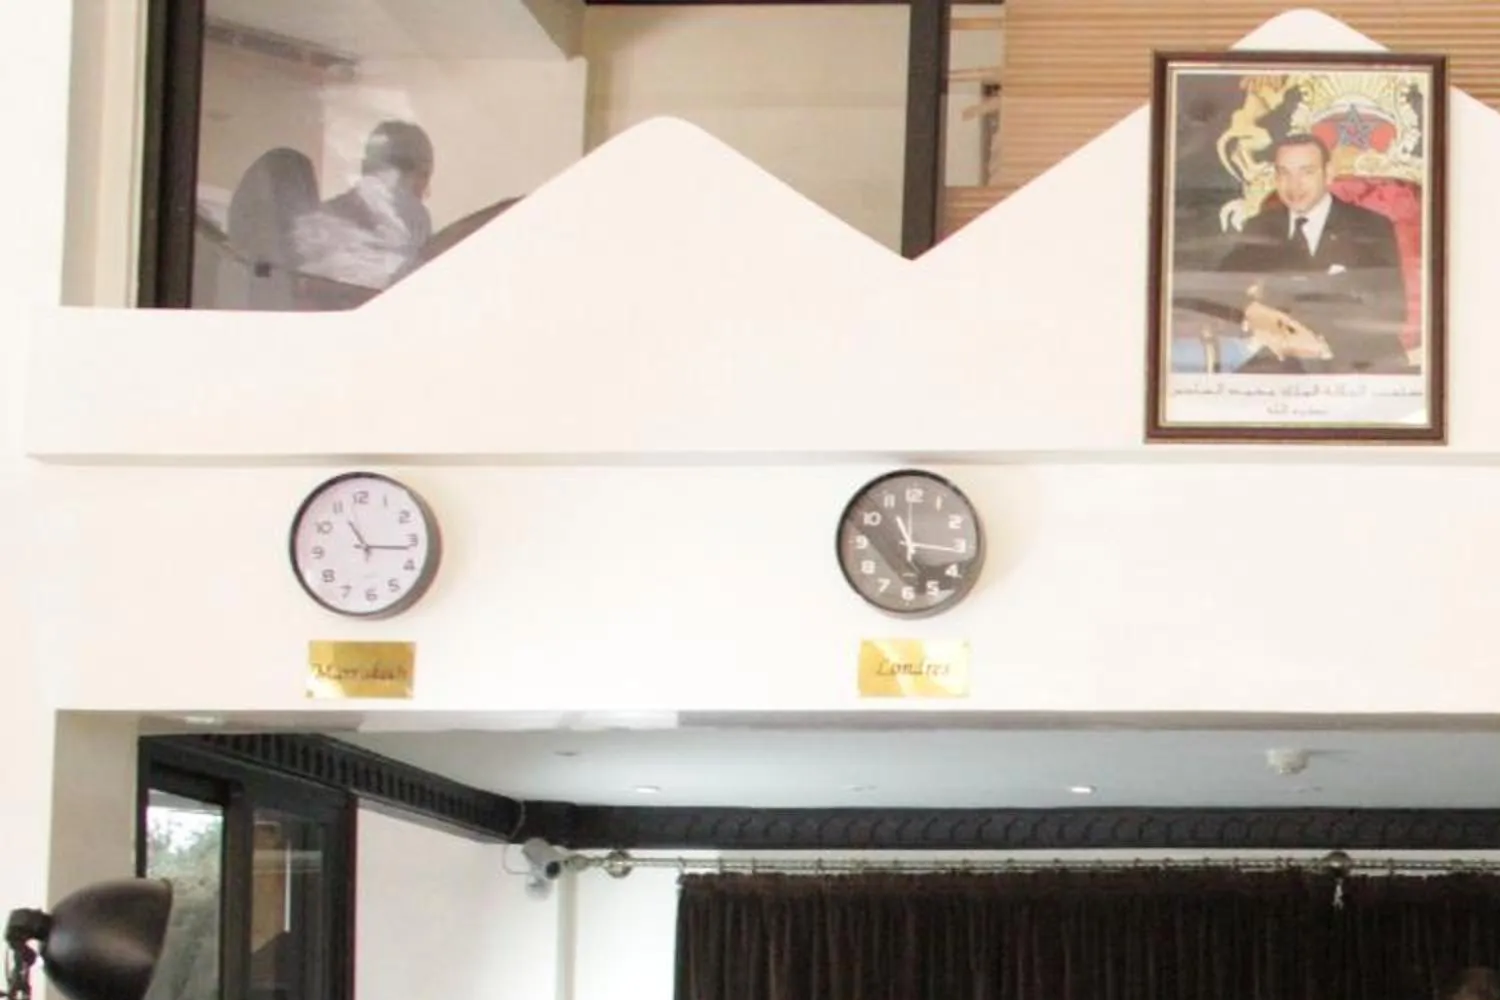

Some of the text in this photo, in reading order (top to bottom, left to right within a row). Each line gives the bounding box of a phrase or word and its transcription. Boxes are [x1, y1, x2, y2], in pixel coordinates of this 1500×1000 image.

[353, 490, 369, 505] 12
[883, 494, 896, 508] 11
[905, 488, 924, 503] 12
[332, 500, 343, 514] 11
[398, 510, 411, 525] 2
[863, 512, 882, 526] 10
[948, 514, 963, 529] 2
[315, 520, 333, 535] 10
[407, 533, 419, 547] 3
[854, 535, 869, 549] 9
[953, 538, 966, 553] 3
[311, 546, 324, 559] 9
[402, 559, 416, 571] 4
[860, 560, 876, 575] 8
[945, 563, 961, 578] 4
[321, 569, 335, 583] 8
[340, 585, 352, 599] 7
[387, 578, 401, 593] 5
[877, 578, 891, 593] 7
[901, 586, 915, 600] 6
[926, 580, 940, 596] 5
[365, 587, 378, 601] 6
[875, 656, 950, 677] Londres
